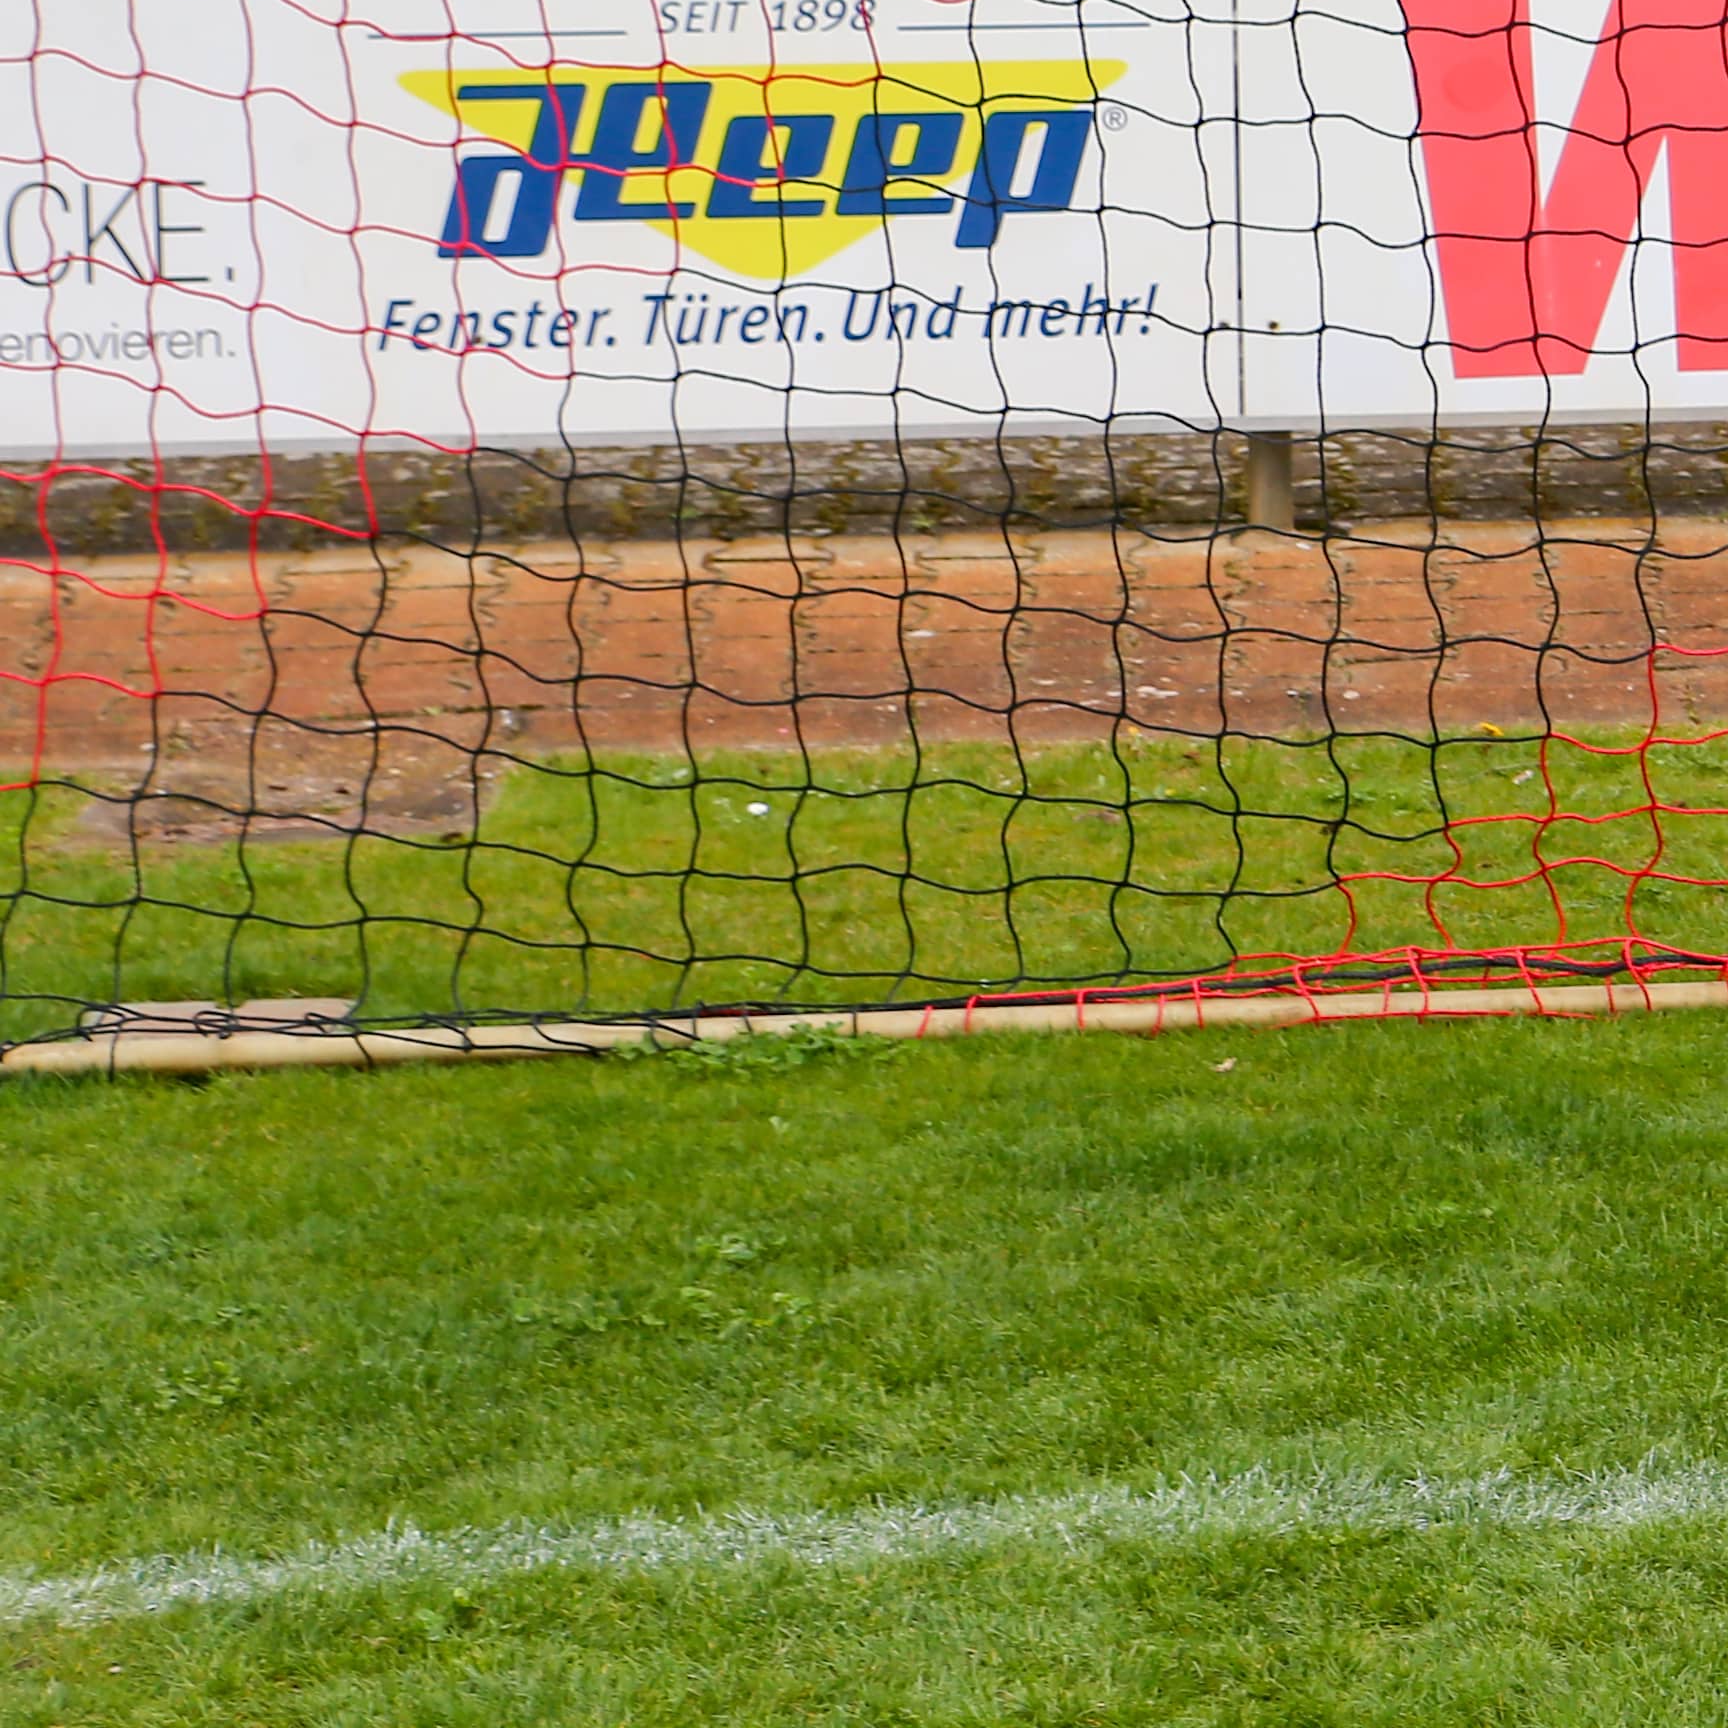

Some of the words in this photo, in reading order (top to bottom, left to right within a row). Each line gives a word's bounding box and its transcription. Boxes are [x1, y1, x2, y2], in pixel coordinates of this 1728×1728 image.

[658, 0, 748, 34] SEIT
[378, 300, 616, 352] Fenster.
[643, 293, 825, 348] Türen.
[842, 285, 963, 342] Und
[982, 282, 1159, 338] mehr!
